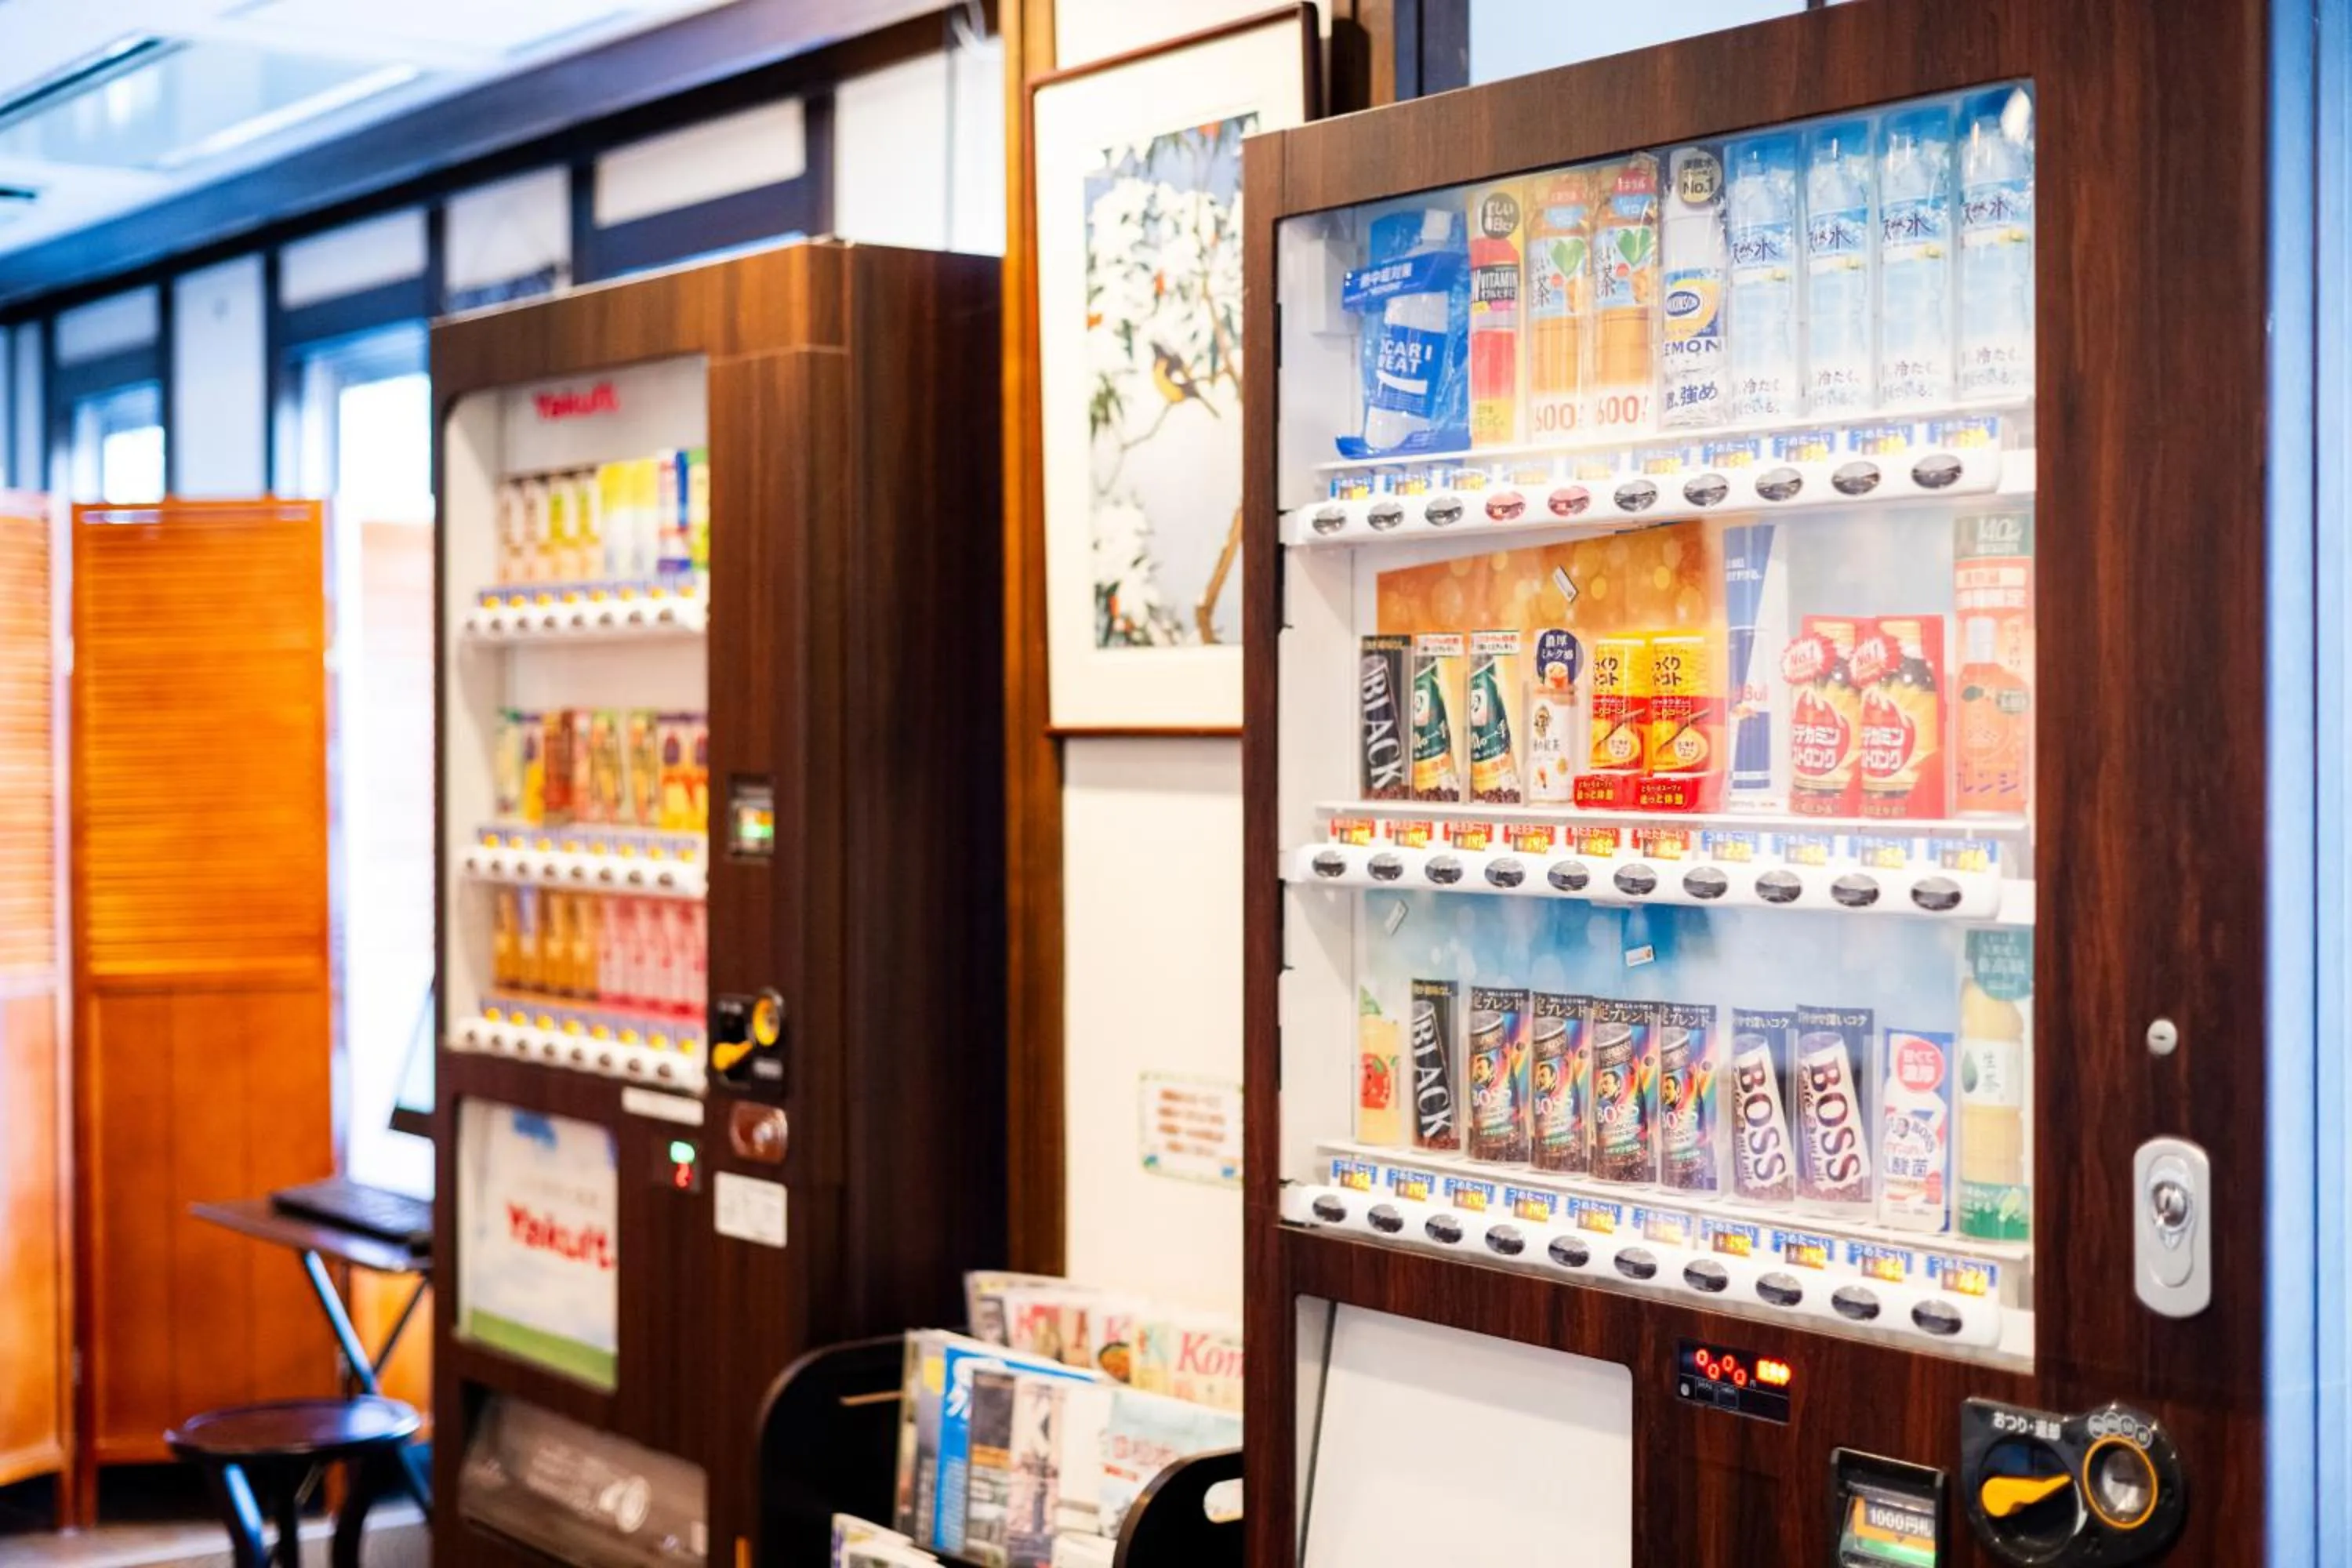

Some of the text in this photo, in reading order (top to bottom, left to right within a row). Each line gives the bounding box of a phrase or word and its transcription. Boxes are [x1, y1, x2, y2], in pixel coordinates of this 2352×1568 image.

[1363, 670, 1404, 789] BLACK
[1413, 1017, 1453, 1137] BLACK
[1738, 1056, 1786, 1182] BOSS
[1809, 1057, 1861, 1182] BOSS
[507, 1200, 616, 1270] Yakult
[1870, 1507, 1932, 1537] 1000円札
